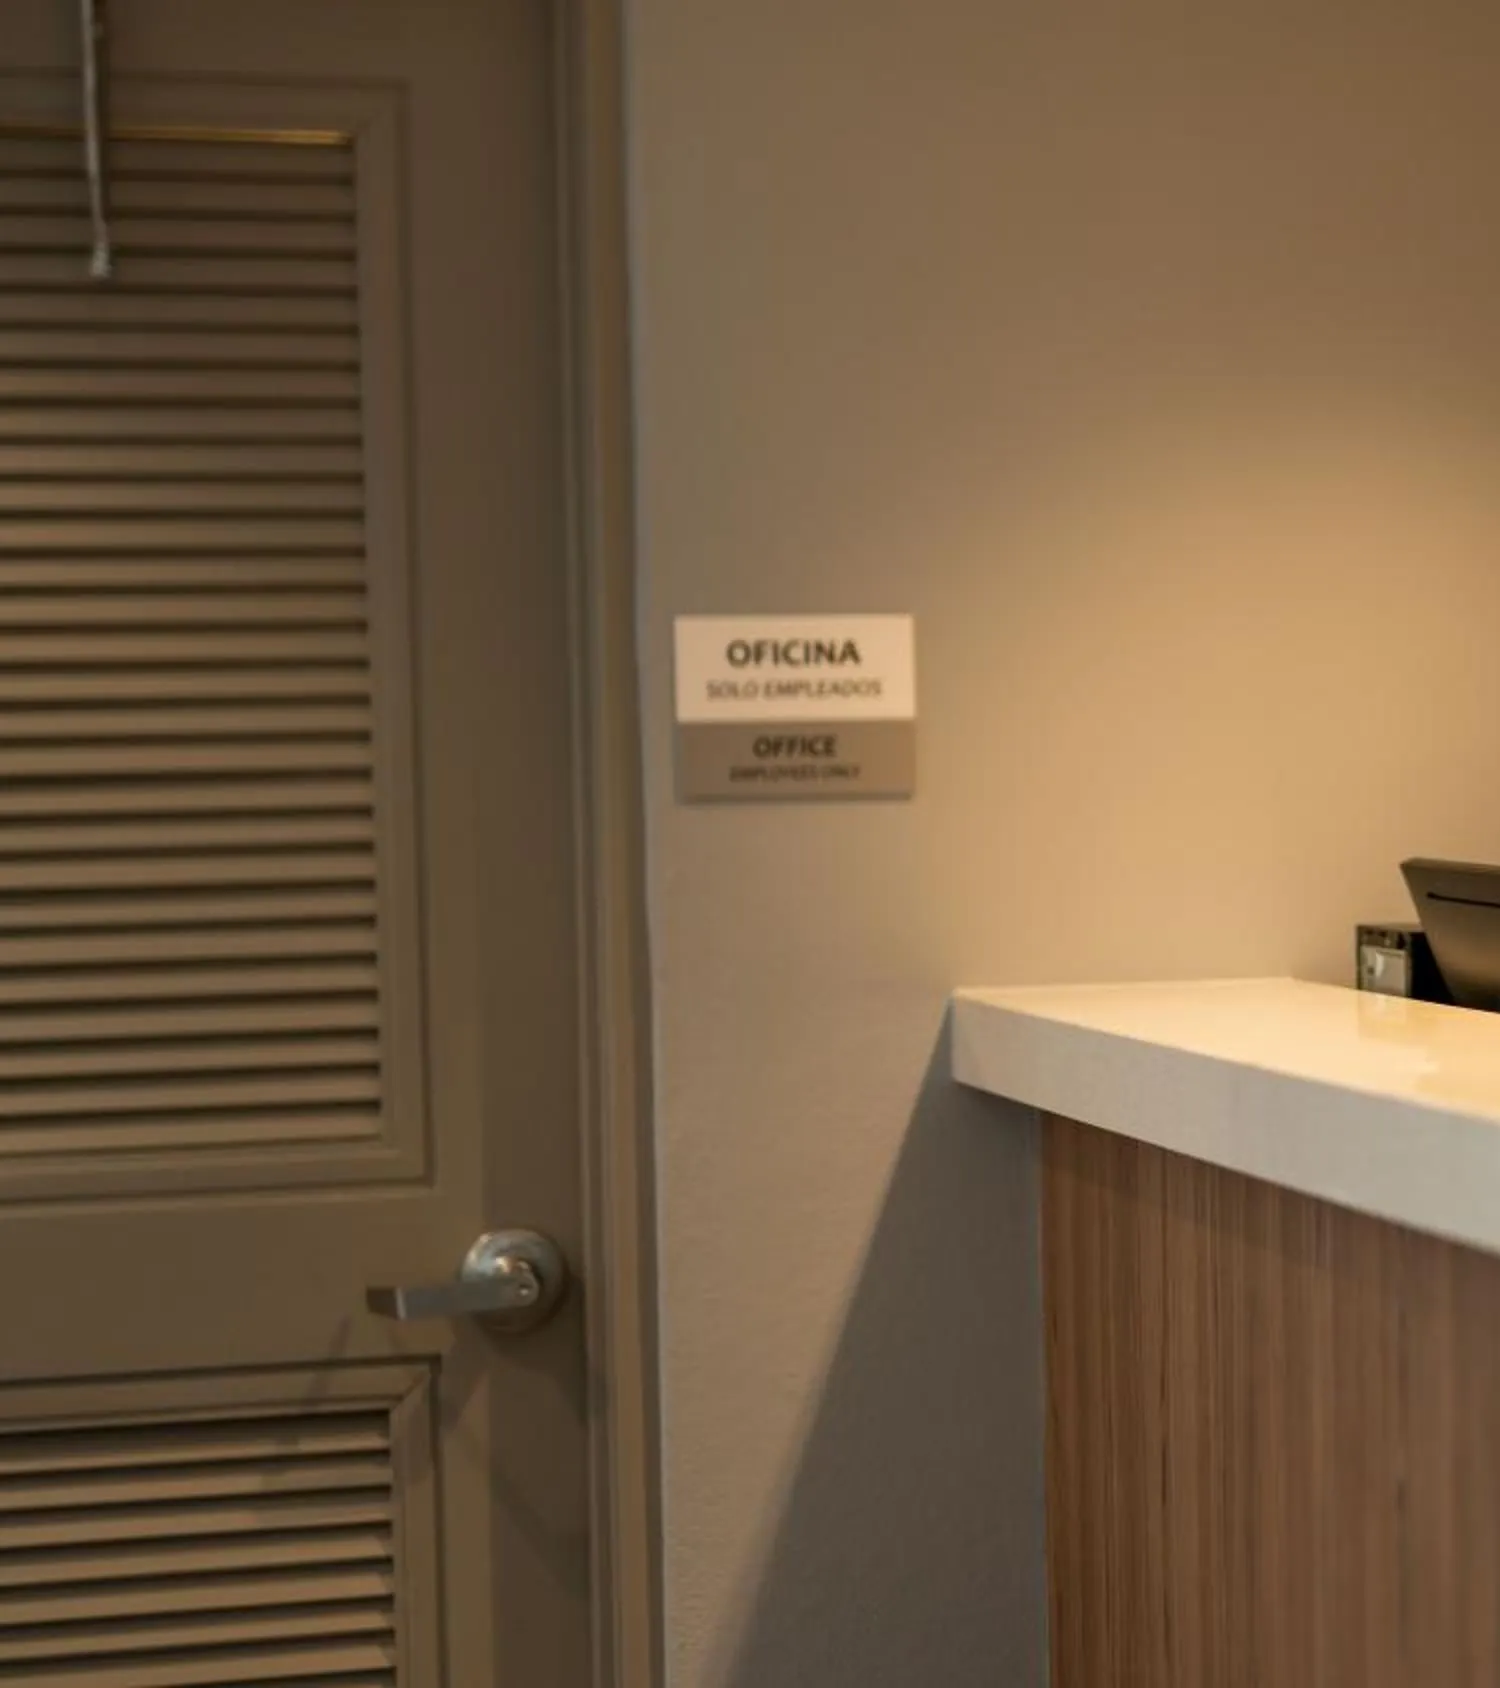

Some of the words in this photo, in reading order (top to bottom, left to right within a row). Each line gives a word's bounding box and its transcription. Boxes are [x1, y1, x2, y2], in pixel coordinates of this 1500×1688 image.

[726, 639, 861, 668] OFICINA
[706, 680, 759, 700] SOLO
[763, 678, 882, 699] EMPLEADOS
[752, 735, 837, 758] OFFICE
